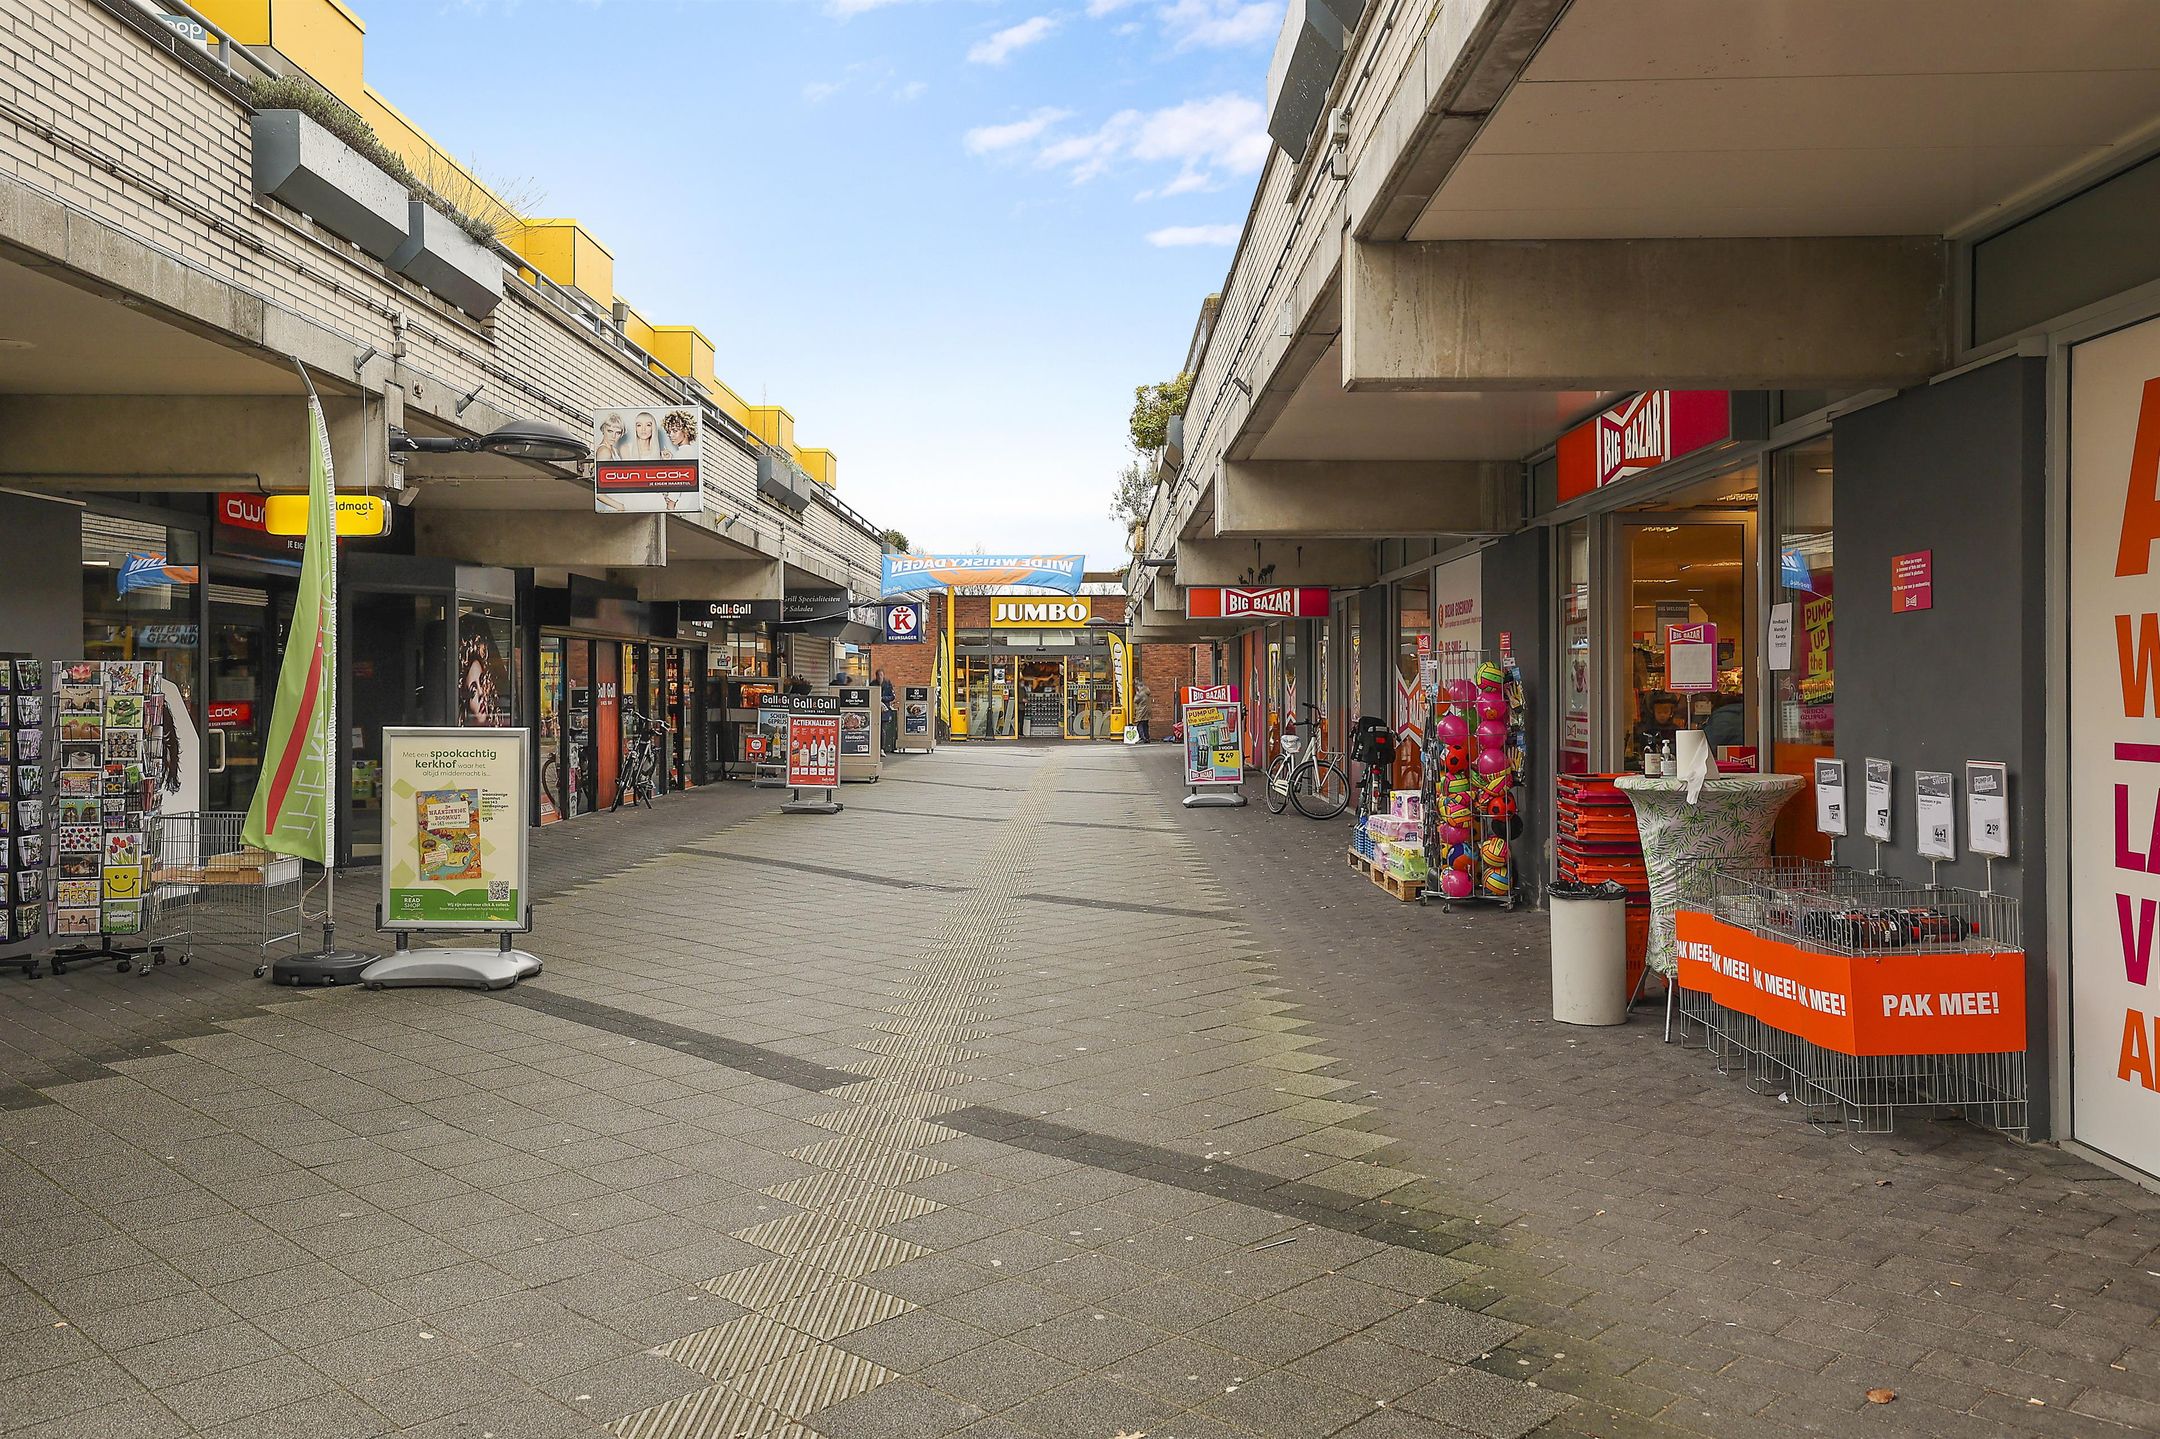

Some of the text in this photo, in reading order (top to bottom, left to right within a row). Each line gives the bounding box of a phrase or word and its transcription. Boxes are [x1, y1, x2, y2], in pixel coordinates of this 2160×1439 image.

[1603, 390, 1662, 476] BIG BAZAR
[335, 502, 374, 511] ldmaat
[798, 595, 841, 604] Specialiteiten
[1229, 590, 1291, 613] BIG BAZAR
[709, 603, 752, 615] Gall&Gall
[994, 603, 1088, 623] JUMBO
[1805, 600, 1832, 626] PUMP
[893, 613, 912, 630] K
[1683, 630, 1700, 639] BAZAR
[1813, 629, 1826, 650] UP
[1809, 655, 1823, 671] the
[1193, 689, 1226, 701] BIG BAZAR
[793, 698, 837, 709] Gall&Gall
[1188, 710, 1208, 719] PUMP
[792, 719, 836, 727] ACTIEKNALLERS
[430, 749, 497, 760] spookachtig
[415, 759, 458, 769] kerkhof
[1934, 828, 1946, 838] 4+1
[1688, 943, 1713, 963] MEE!
[1723, 958, 1750, 983] MEE!
[1753, 967, 1797, 1000] AK MEE!
[1799, 983, 1847, 1016] AK MEE!
[1882, 991, 1999, 1017] PAK MEE!
